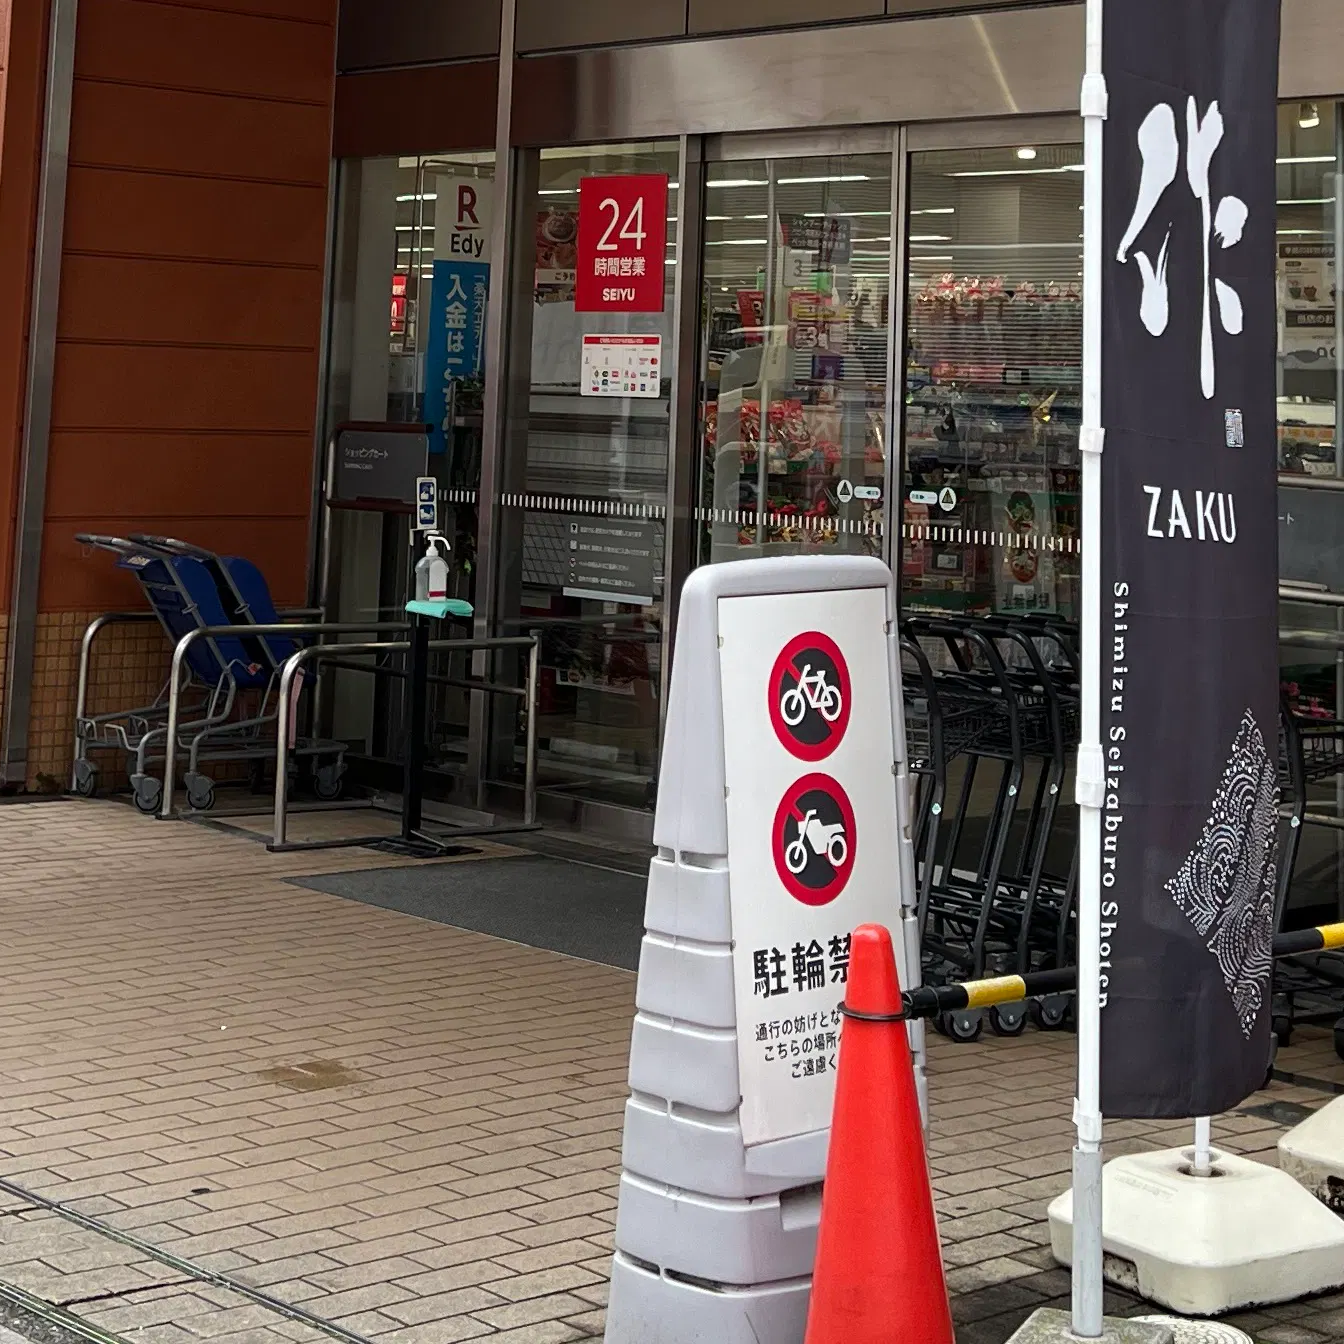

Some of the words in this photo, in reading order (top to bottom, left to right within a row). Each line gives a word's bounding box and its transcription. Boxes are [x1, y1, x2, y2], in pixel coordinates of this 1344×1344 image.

[457, 185, 479, 225] R
[596, 197, 647, 251] 24
[451, 234, 484, 257] Edy
[594, 257, 646, 278] 時間営業
[602, 288, 636, 302] SEIYU
[1143, 485, 1238, 544] ZAKU
[1111, 582, 1129, 712] Shimizu
[1102, 726, 1126, 887] Seizaburo
[1099, 901, 1118, 1008] Shoten
[791, 1053, 837, 1079] ご遠慮く
